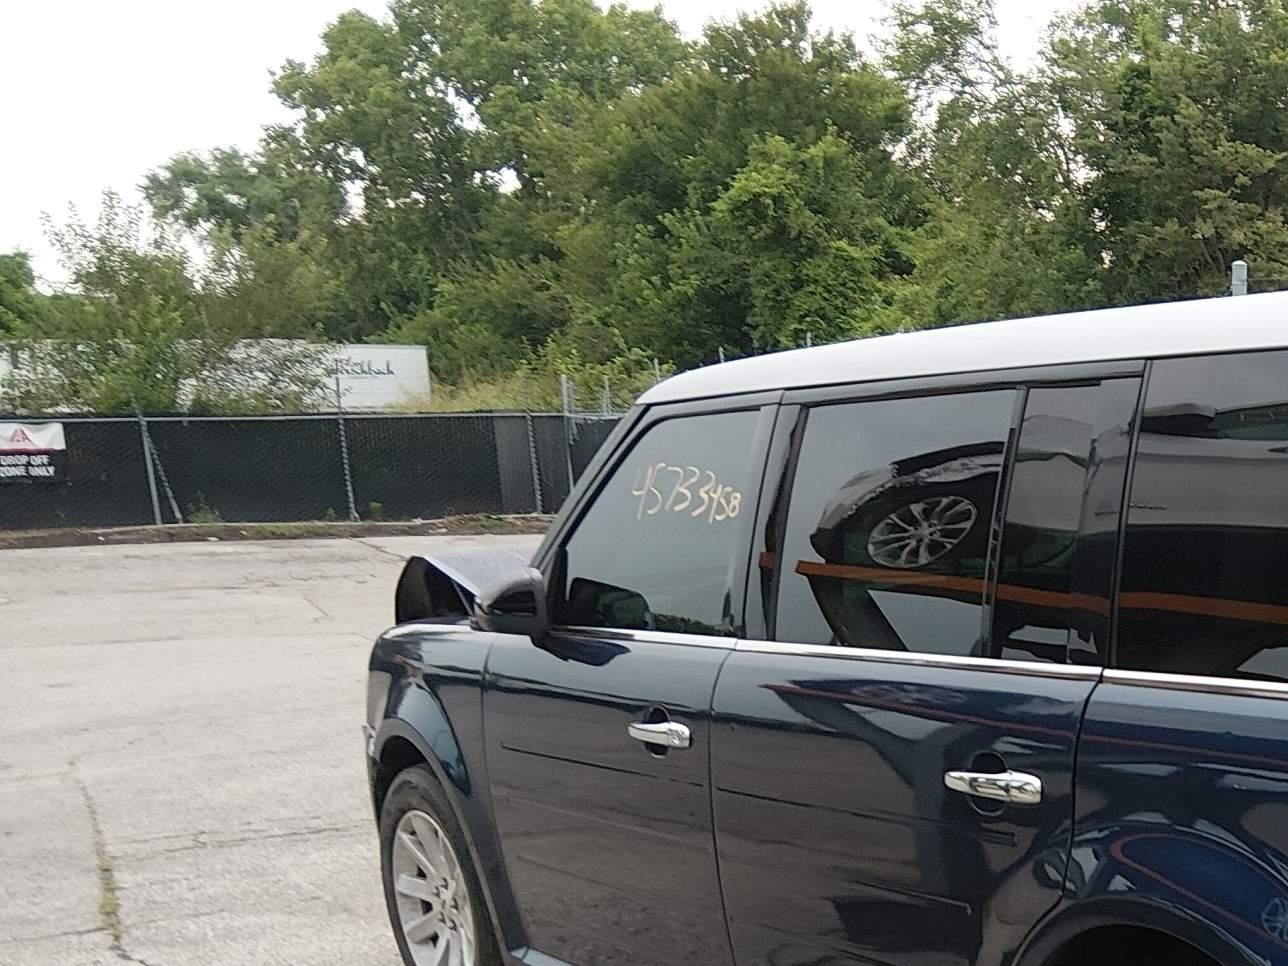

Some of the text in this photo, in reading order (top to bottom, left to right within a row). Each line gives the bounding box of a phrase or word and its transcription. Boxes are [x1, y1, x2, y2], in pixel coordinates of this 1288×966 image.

[0, 454, 50, 466] DROP OFF
[28, 466, 56, 477] ONLY
[632, 462, 743, 524] 45733458
